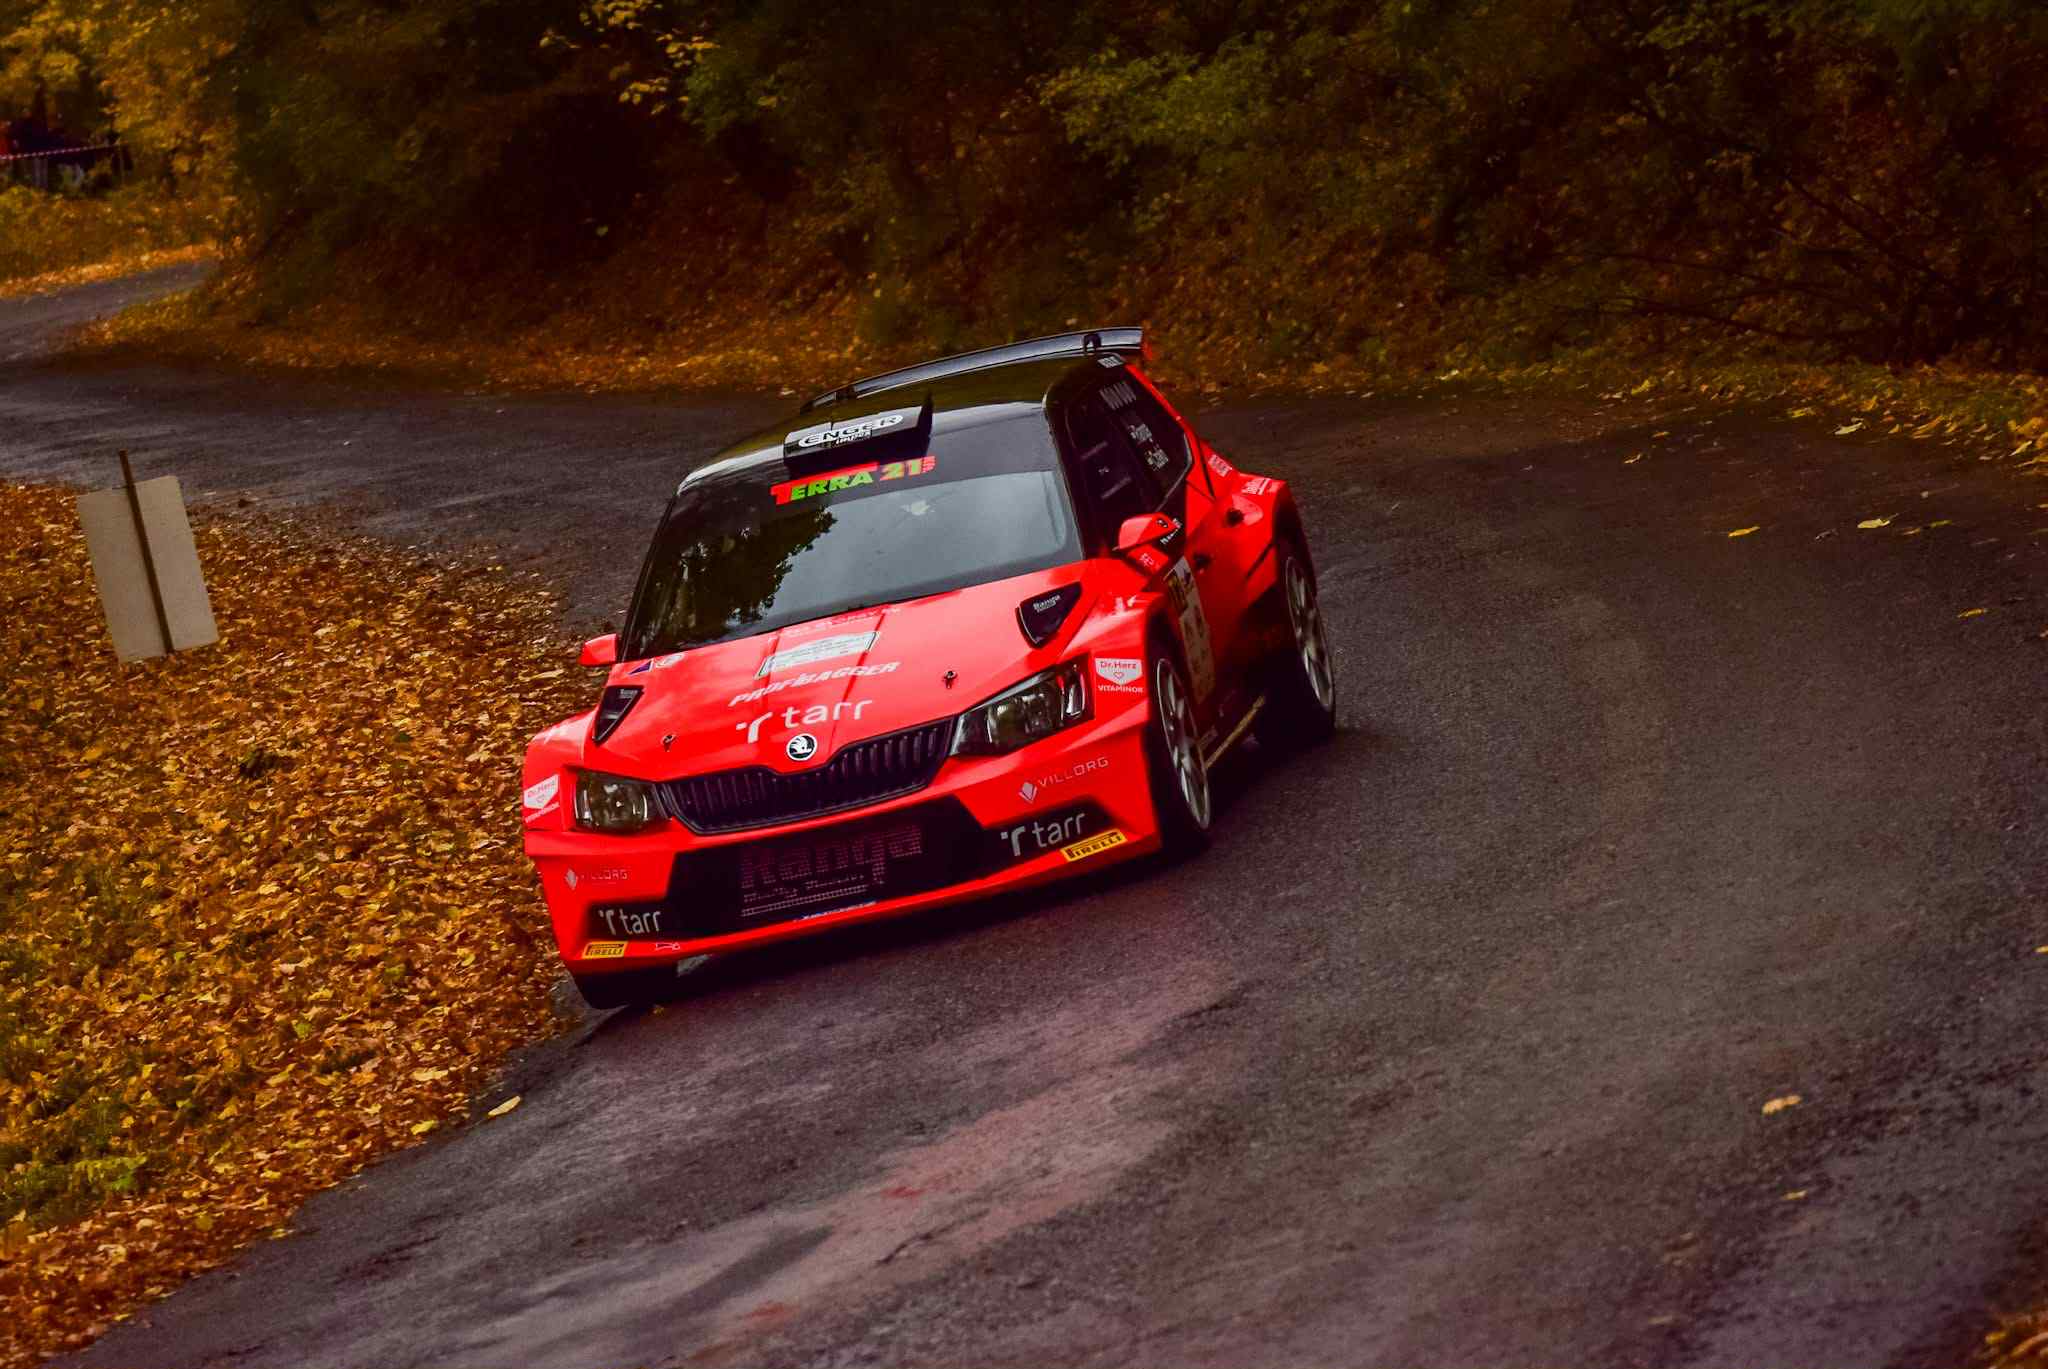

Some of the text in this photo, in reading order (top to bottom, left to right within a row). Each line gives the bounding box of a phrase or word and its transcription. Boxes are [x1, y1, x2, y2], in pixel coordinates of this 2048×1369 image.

[770, 461, 880, 505] TERRA
[781, 700, 873, 729] tarr
[1031, 813, 1086, 848] tarr
[619, 908, 661, 935] tarr
